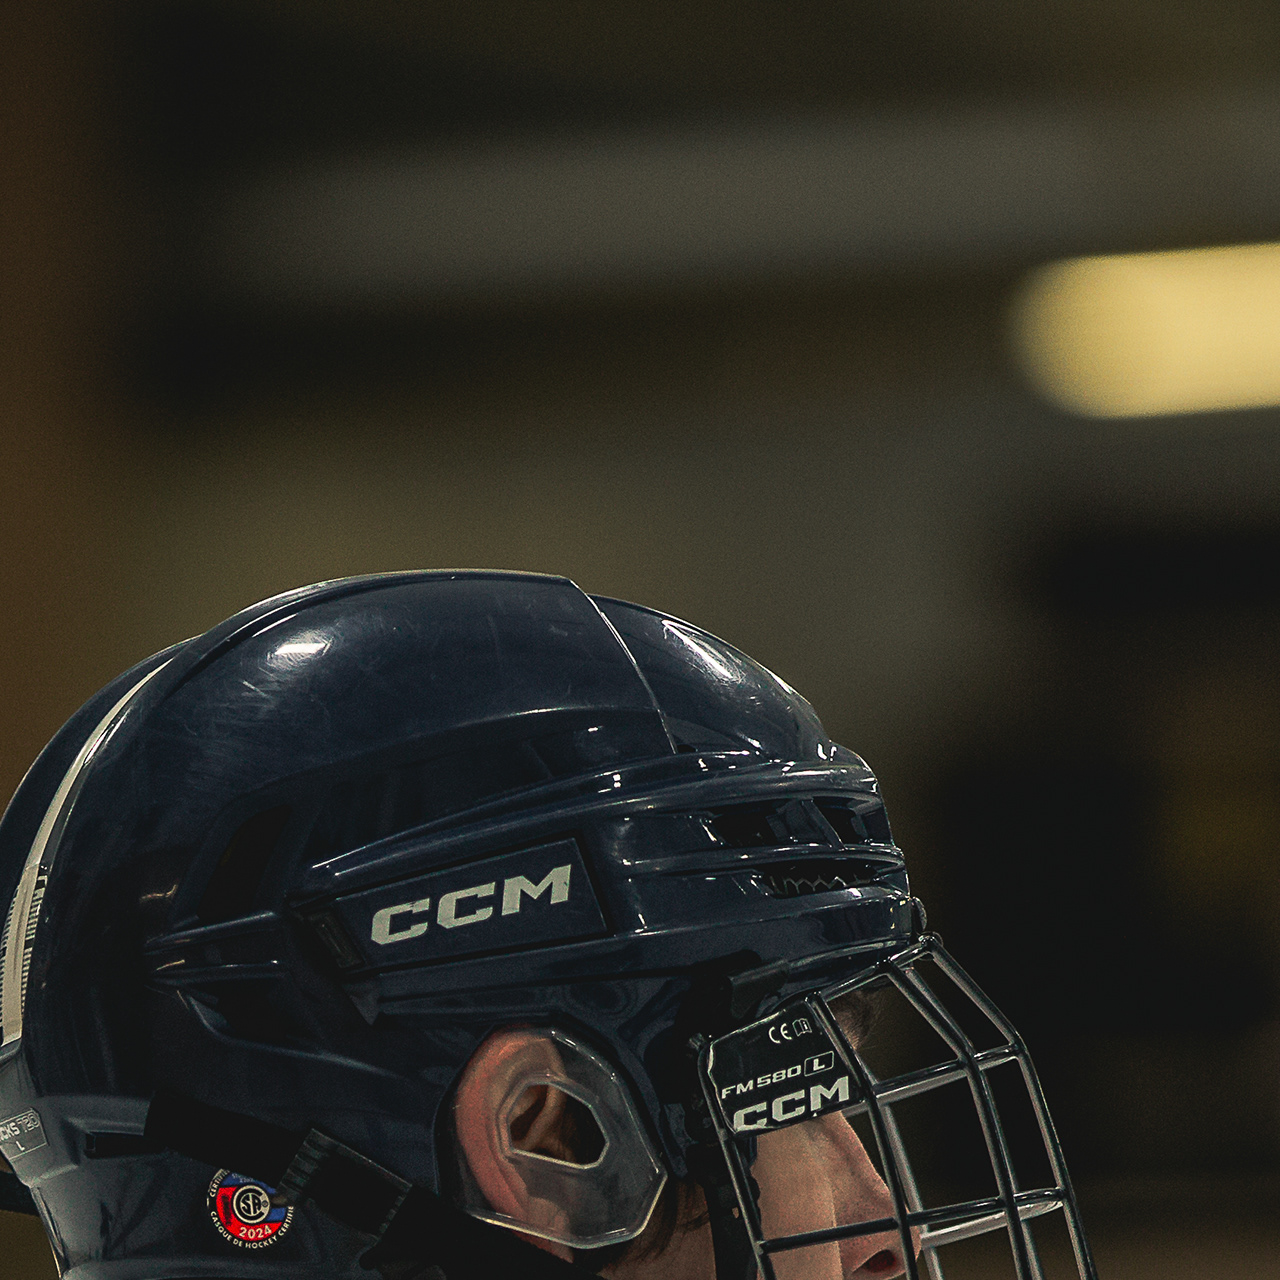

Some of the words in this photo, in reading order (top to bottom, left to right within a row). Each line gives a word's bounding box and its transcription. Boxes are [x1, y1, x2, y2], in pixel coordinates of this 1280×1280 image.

[370, 864, 572, 946] CCM
[732, 1075, 850, 1132] CCM
[210, 1210, 233, 1241] CASQUE
[232, 1237, 243, 1248] DE
[244, 1234, 279, 1250] HOCKEY
[238, 1224, 273, 1240] 2024
